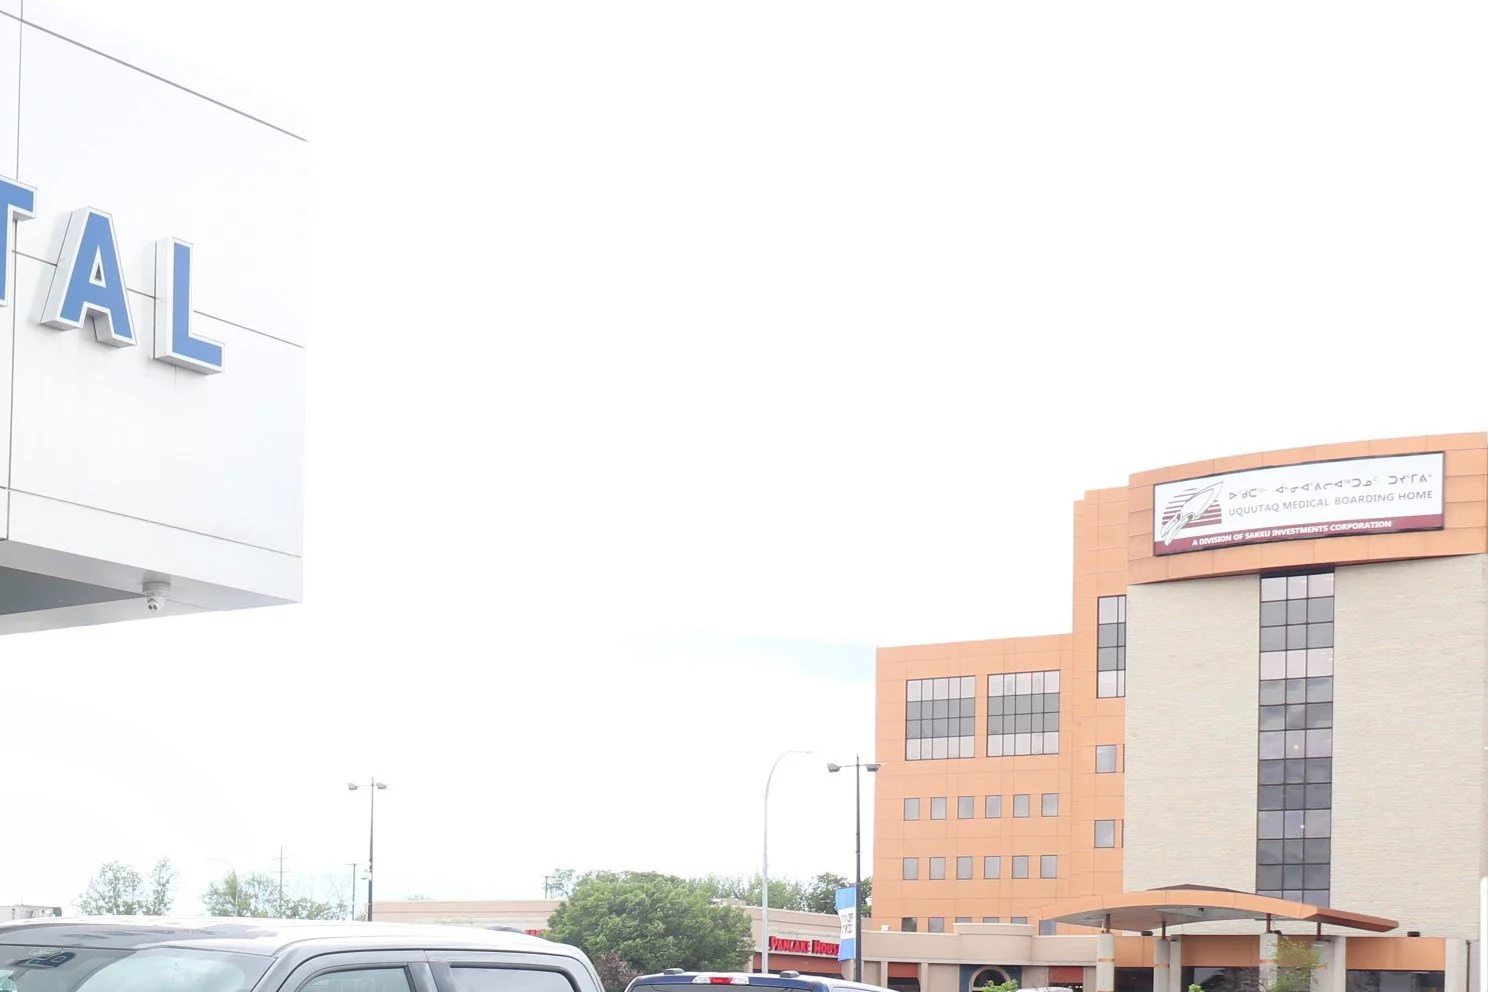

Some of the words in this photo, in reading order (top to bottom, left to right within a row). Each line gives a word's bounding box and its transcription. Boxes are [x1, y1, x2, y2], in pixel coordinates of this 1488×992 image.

[1228, 502, 1280, 516] UQUUTAQ
[1282, 498, 1329, 510] MEDICAL
[1334, 493, 1395, 506] BOARDING
[1398, 490, 1433, 501] HOME
[1199, 535, 1232, 545] DIVISION
[1233, 533, 1244, 541] OF
[1245, 530, 1271, 539] SAKKU
[1272, 524, 1329, 537] INVESTMENTS
[1330, 520, 1392, 532] CORPORATION
